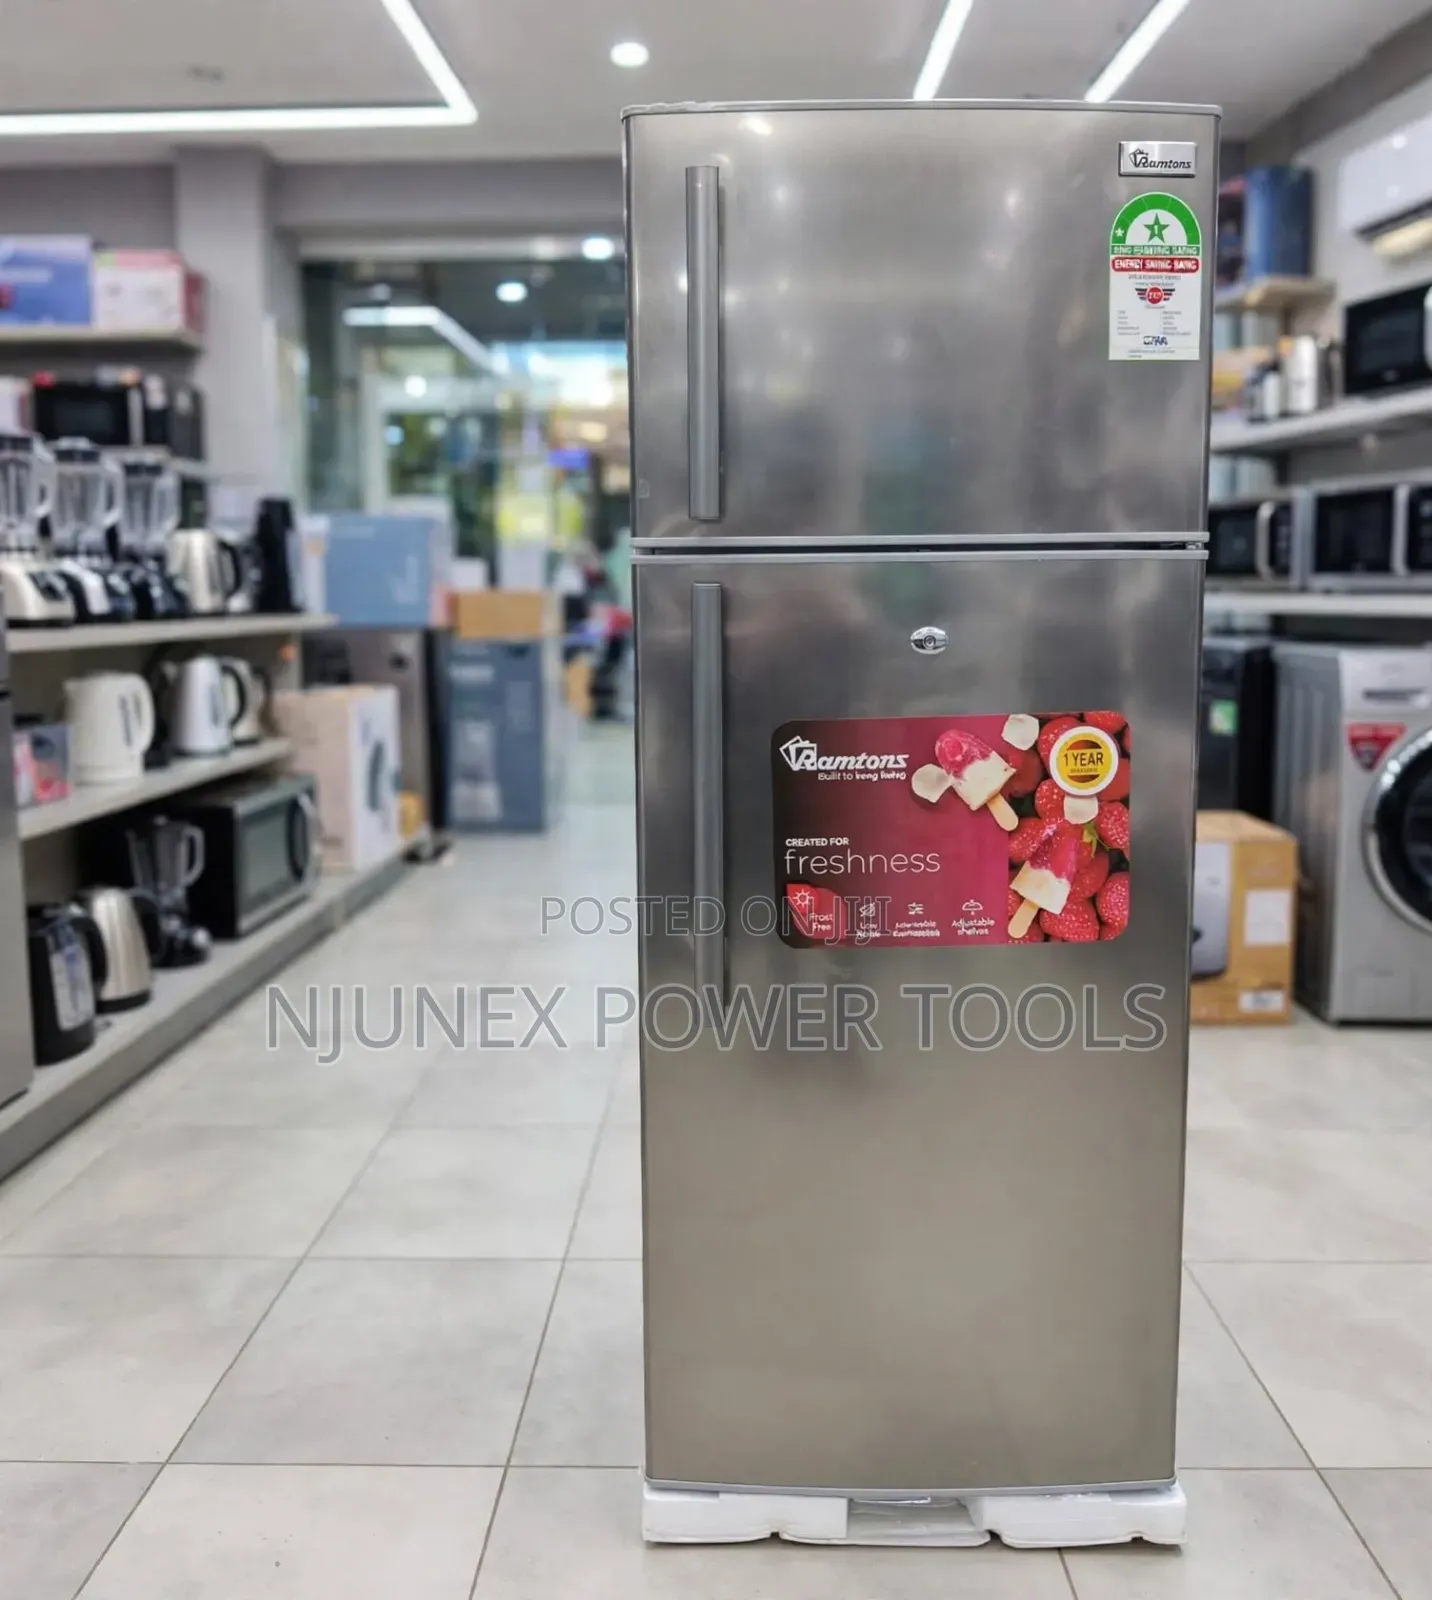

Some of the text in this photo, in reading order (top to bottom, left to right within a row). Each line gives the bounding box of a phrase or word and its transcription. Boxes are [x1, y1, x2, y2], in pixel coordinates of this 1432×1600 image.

[1133, 154, 1192, 169] Ramtons
[788, 743, 910, 771] Ramtons
[1063, 752, 1104, 767] 1 YEAR
[785, 837, 850, 847] CREATED FOR
[784, 848, 941, 875] freshness
